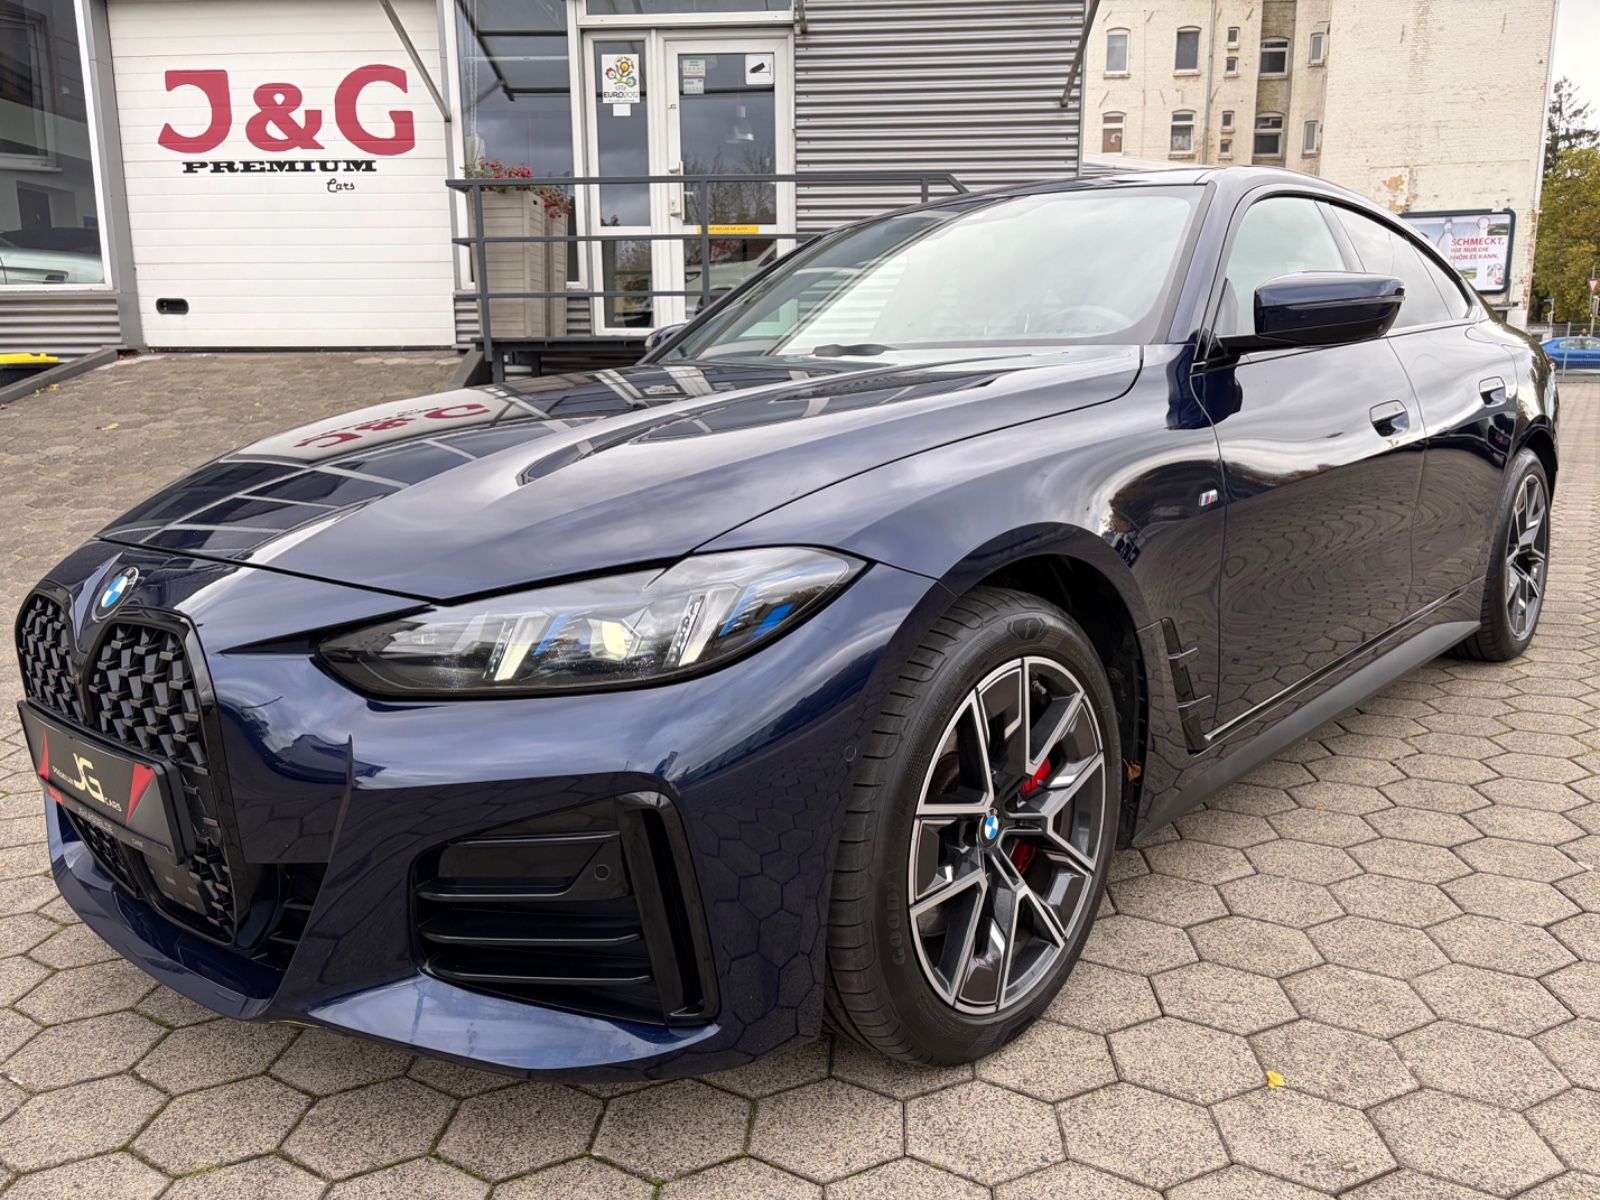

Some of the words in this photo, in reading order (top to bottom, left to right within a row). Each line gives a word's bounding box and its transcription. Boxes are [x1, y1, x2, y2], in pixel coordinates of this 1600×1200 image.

[157, 64, 416, 156] J&G
[182, 160, 377, 173] PREMIUM
[326, 178, 355, 193] Cars
[1451, 237, 1504, 246] SCHMECKT,
